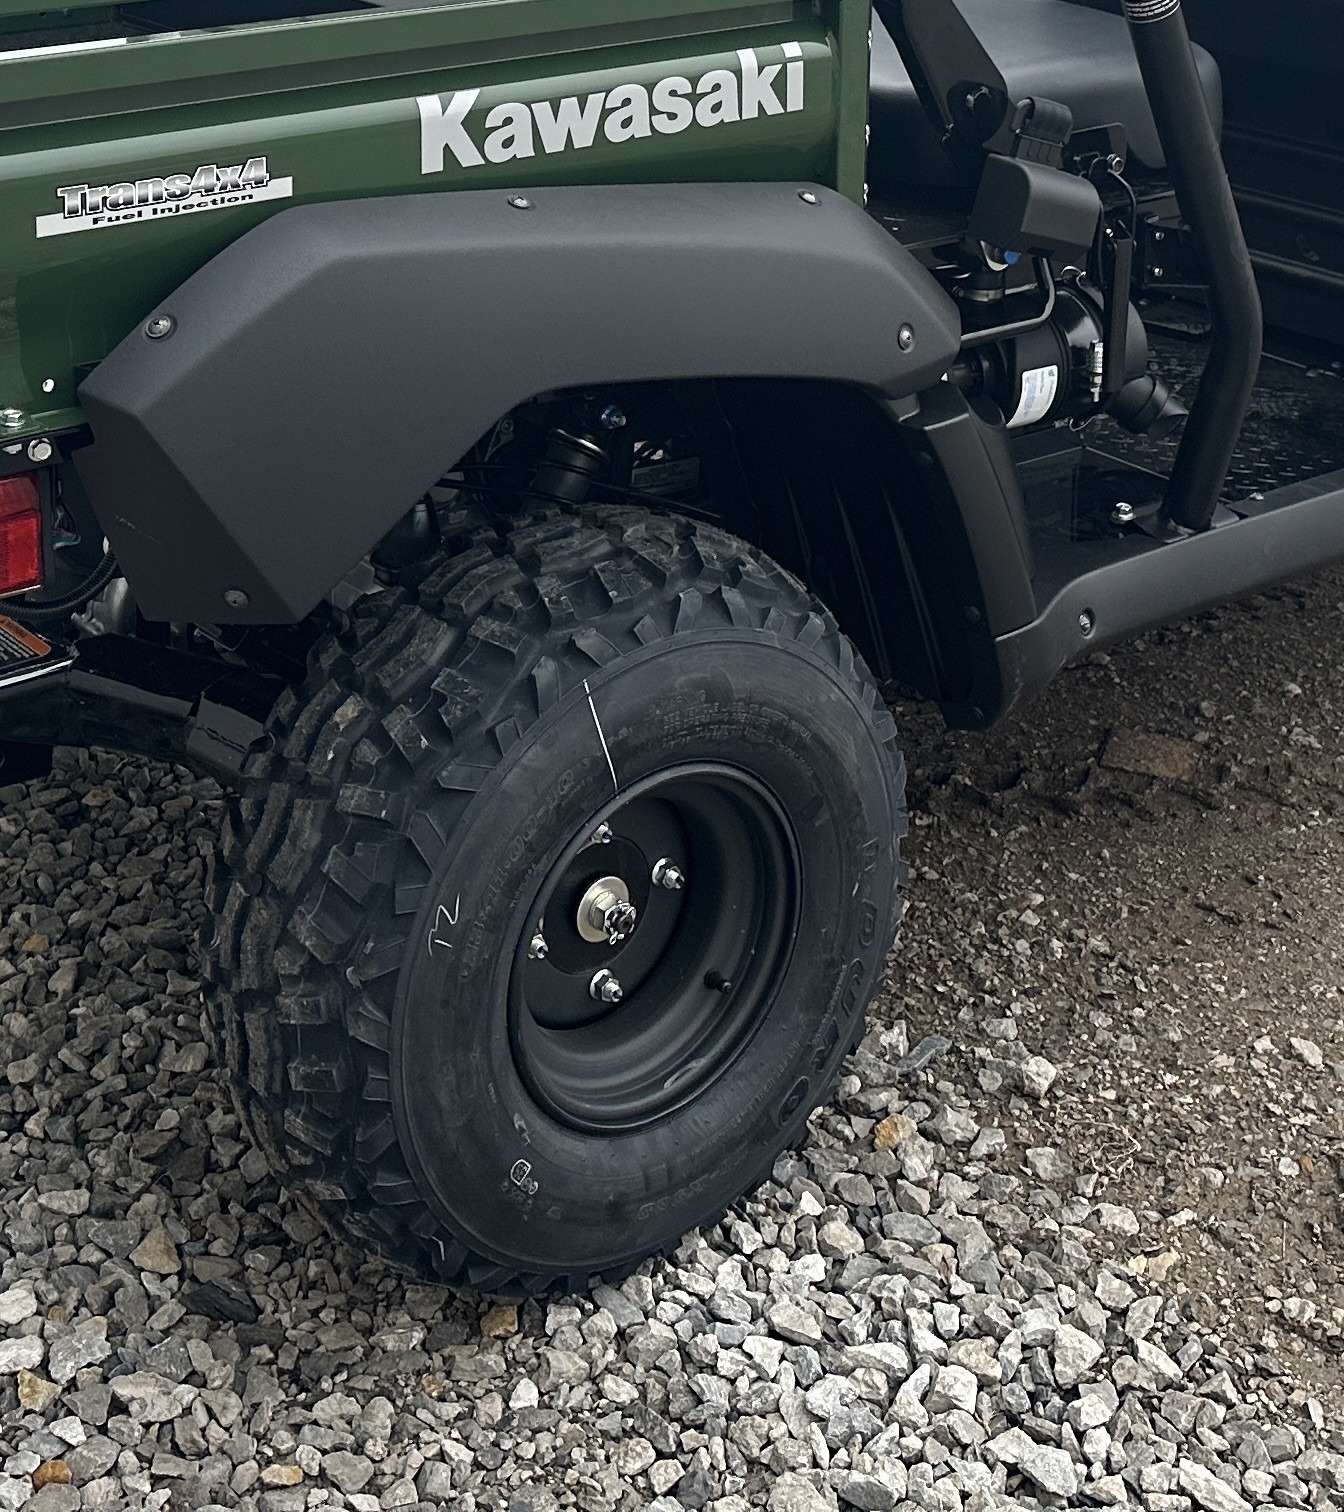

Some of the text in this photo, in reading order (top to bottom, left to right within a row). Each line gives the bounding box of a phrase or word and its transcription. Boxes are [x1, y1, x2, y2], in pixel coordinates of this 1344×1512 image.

[416, 41, 805, 175] Kawasaki
[57, 156, 270, 219] Trans4x4
[92, 193, 254, 226] Fuel Injection
